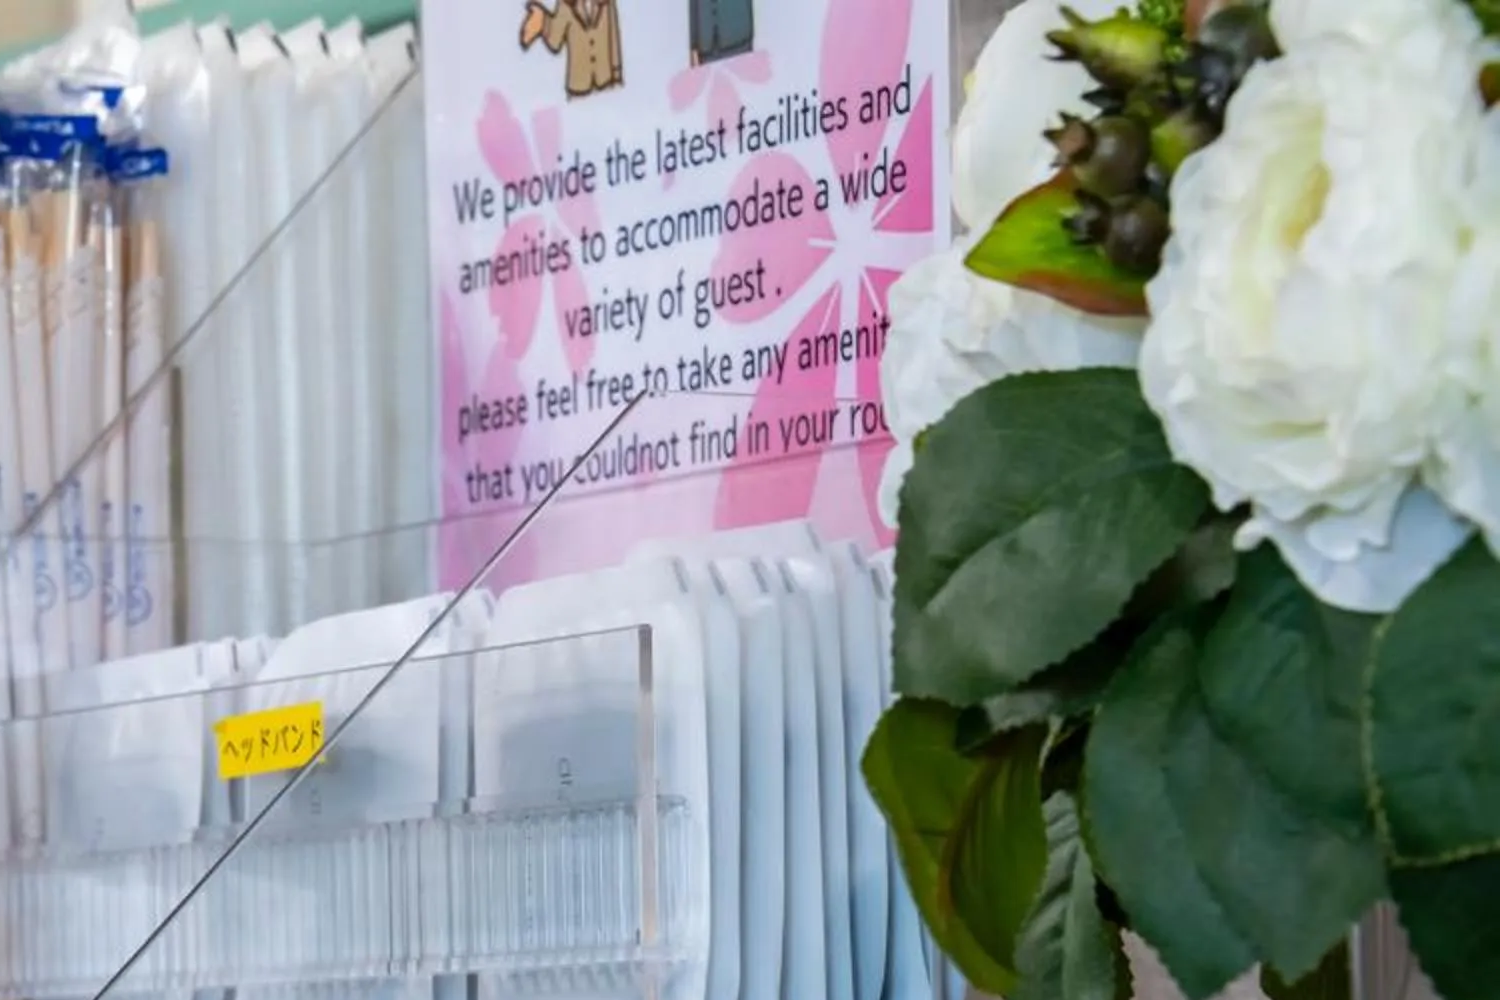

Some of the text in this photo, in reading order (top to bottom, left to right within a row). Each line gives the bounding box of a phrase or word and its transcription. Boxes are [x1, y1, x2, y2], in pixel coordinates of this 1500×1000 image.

[453, 63, 911, 228] We provide the latest facilities and
[459, 147, 907, 295] amenities to accommodate a wide
[565, 287, 648, 342] variety
[658, 268, 685, 320] of
[458, 310, 891, 446] please feel free to take any amenit
[466, 461, 514, 503] that
[521, 456, 564, 503] you
[573, 432, 680, 485] couldnot
[689, 413, 738, 465] find
[747, 411, 770, 456] in
[778, 408, 841, 453] your
[222, 717, 321, 763] ヘッドバンド
